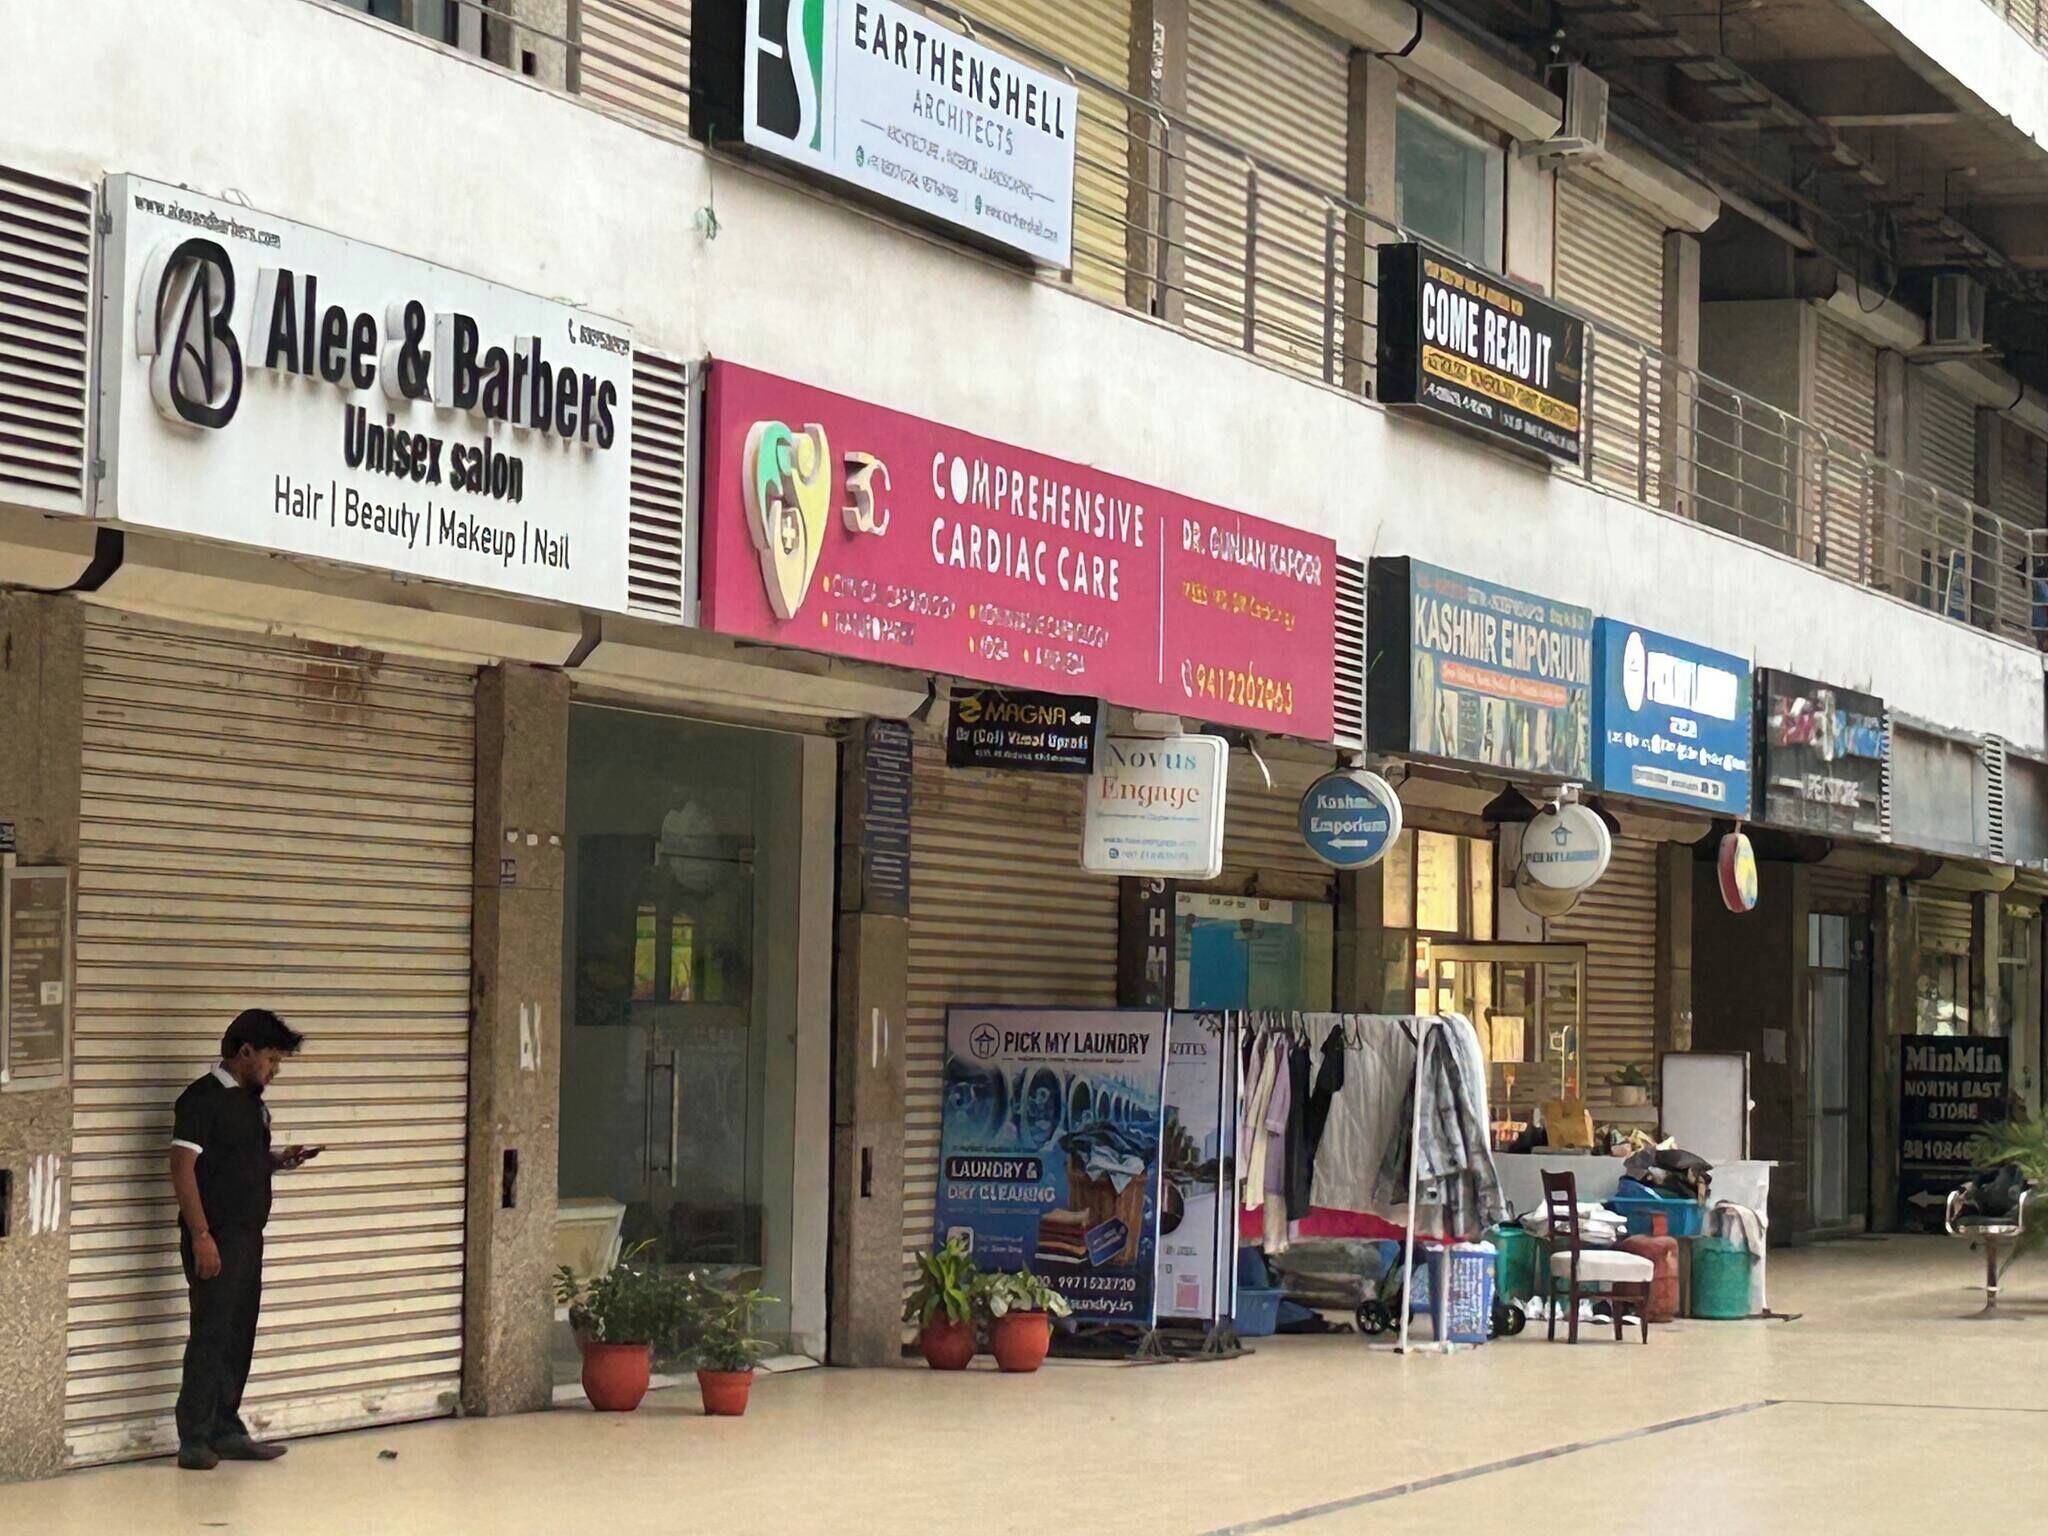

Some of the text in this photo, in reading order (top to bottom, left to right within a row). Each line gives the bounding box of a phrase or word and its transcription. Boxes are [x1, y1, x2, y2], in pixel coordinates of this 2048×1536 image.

[854, 2, 1065, 139] EARTHENSHELL
[912, 89, 1014, 156] ARCHITECTS
[264, 267, 617, 450] Alee & Barbers
[1422, 281, 1480, 359] COME
[1483, 308, 1531, 380] READ
[1535, 332, 1552, 389] IT
[344, 403, 524, 503] Unisex salon
[274, 474, 570, 570] Hair Beauty Makeup Nail
[931, 451, 1145, 548] COMPREHENSIVE
[931, 516, 1120, 602] CARDIAC CARE
[1182, 518, 1206, 556] DR.
[1414, 593, 1498, 665] KASHMIR
[1500, 619, 1592, 685] EMPORIUM
[984, 701, 1066, 727] MAGNA
[1107, 743, 1197, 771] Novus
[1003, 1031, 1150, 1056] PICK MY LAUNDRY
[1905, 1045, 2004, 1074] MinMin
[1904, 1080, 2002, 1098] NORTH EAST
[1928, 1102, 1979, 1120] STORE
[947, 1185, 1057, 1203] DRY CLEANING
[950, 1159, 1038, 1179] LAUNDRY &
